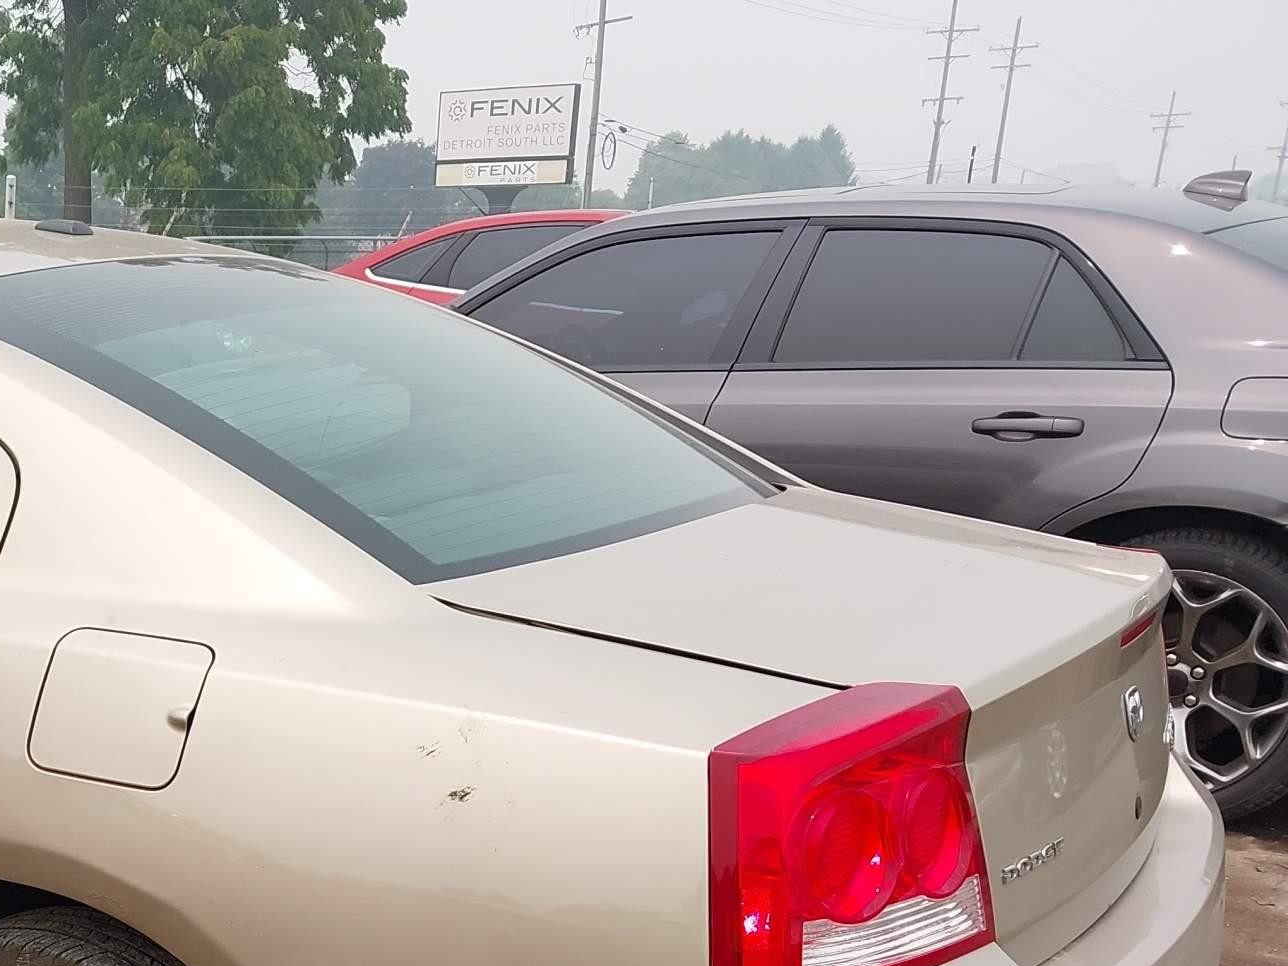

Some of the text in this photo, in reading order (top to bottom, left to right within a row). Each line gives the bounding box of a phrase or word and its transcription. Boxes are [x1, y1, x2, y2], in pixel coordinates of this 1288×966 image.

[470, 97, 563, 117] FENIX
[487, 122, 566, 136] FENIX PARTS
[443, 135, 565, 151] DETROIT SOUTH LLC
[477, 163, 536, 176] FENIX
[499, 176, 536, 184] PARTS
